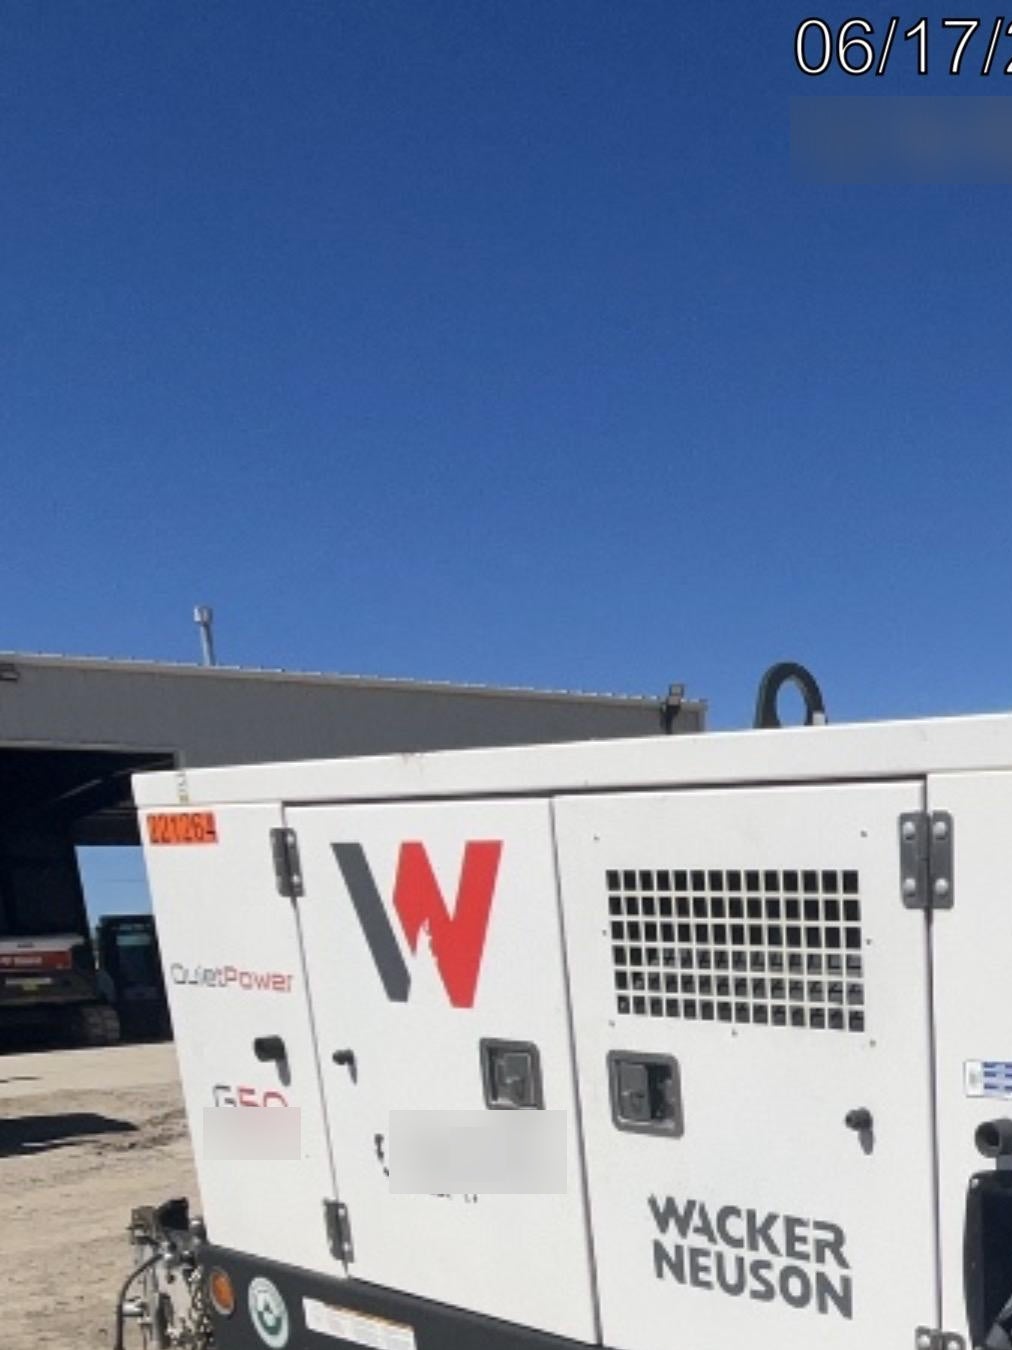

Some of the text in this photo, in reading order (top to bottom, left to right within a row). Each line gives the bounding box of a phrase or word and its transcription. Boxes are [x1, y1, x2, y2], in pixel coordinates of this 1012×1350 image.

[170, 963, 293, 993] QuietPower
[648, 1194, 851, 1269] WACKER
[652, 1238, 853, 1321] NEUSON
